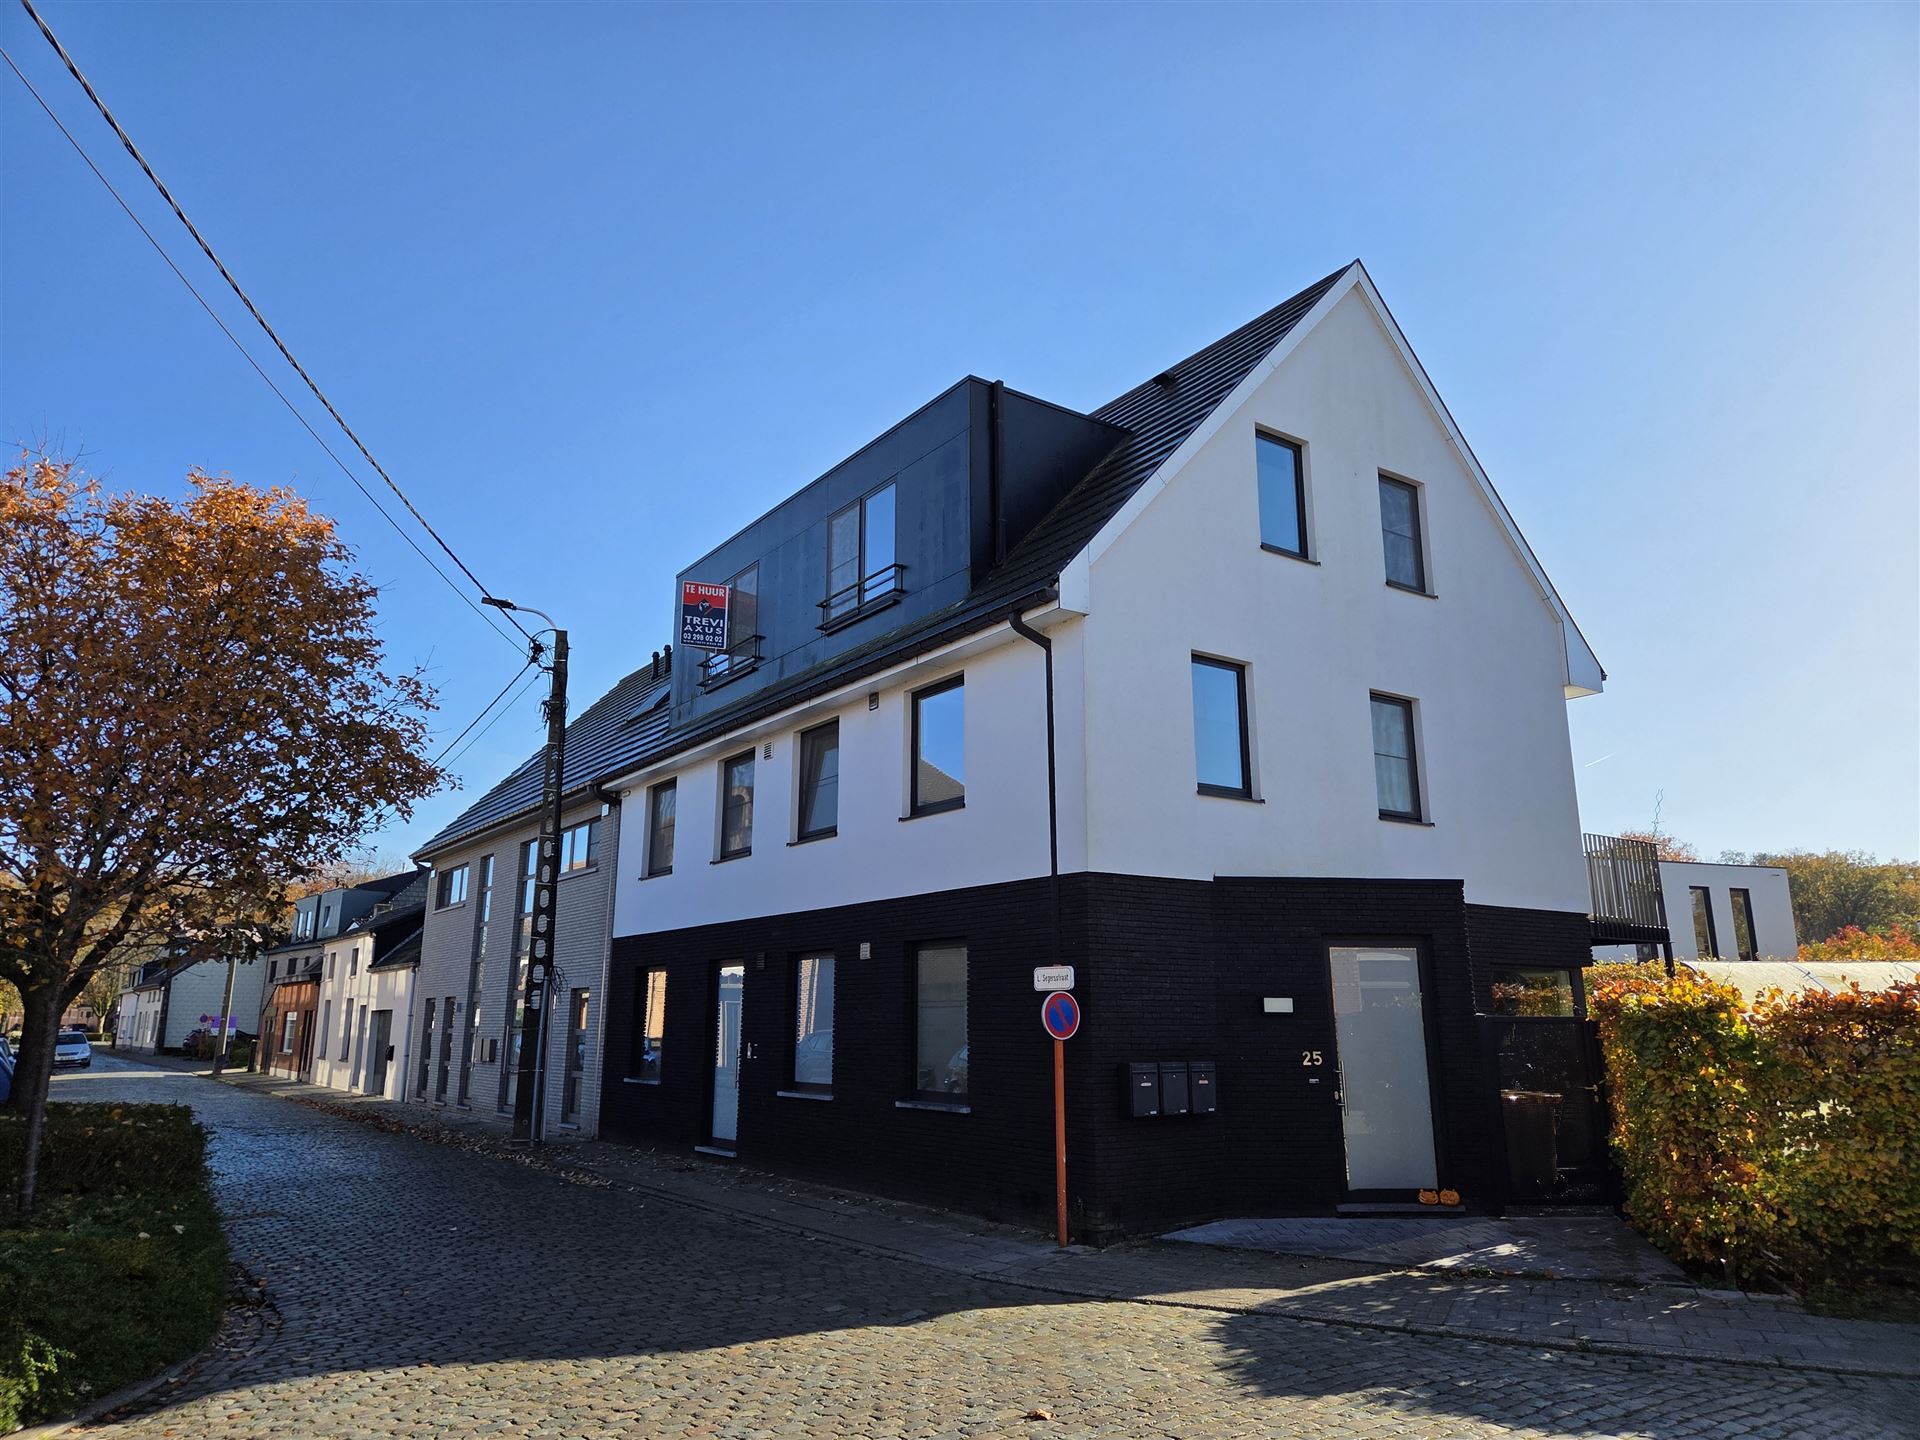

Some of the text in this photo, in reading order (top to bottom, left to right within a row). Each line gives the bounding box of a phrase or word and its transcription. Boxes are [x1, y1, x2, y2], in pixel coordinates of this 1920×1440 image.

[685, 584, 724, 596] TE HUUR
[684, 616, 723, 627] TREVI
[684, 625, 722, 635] AXUS
[1302, 1051, 1323, 1066] 25
